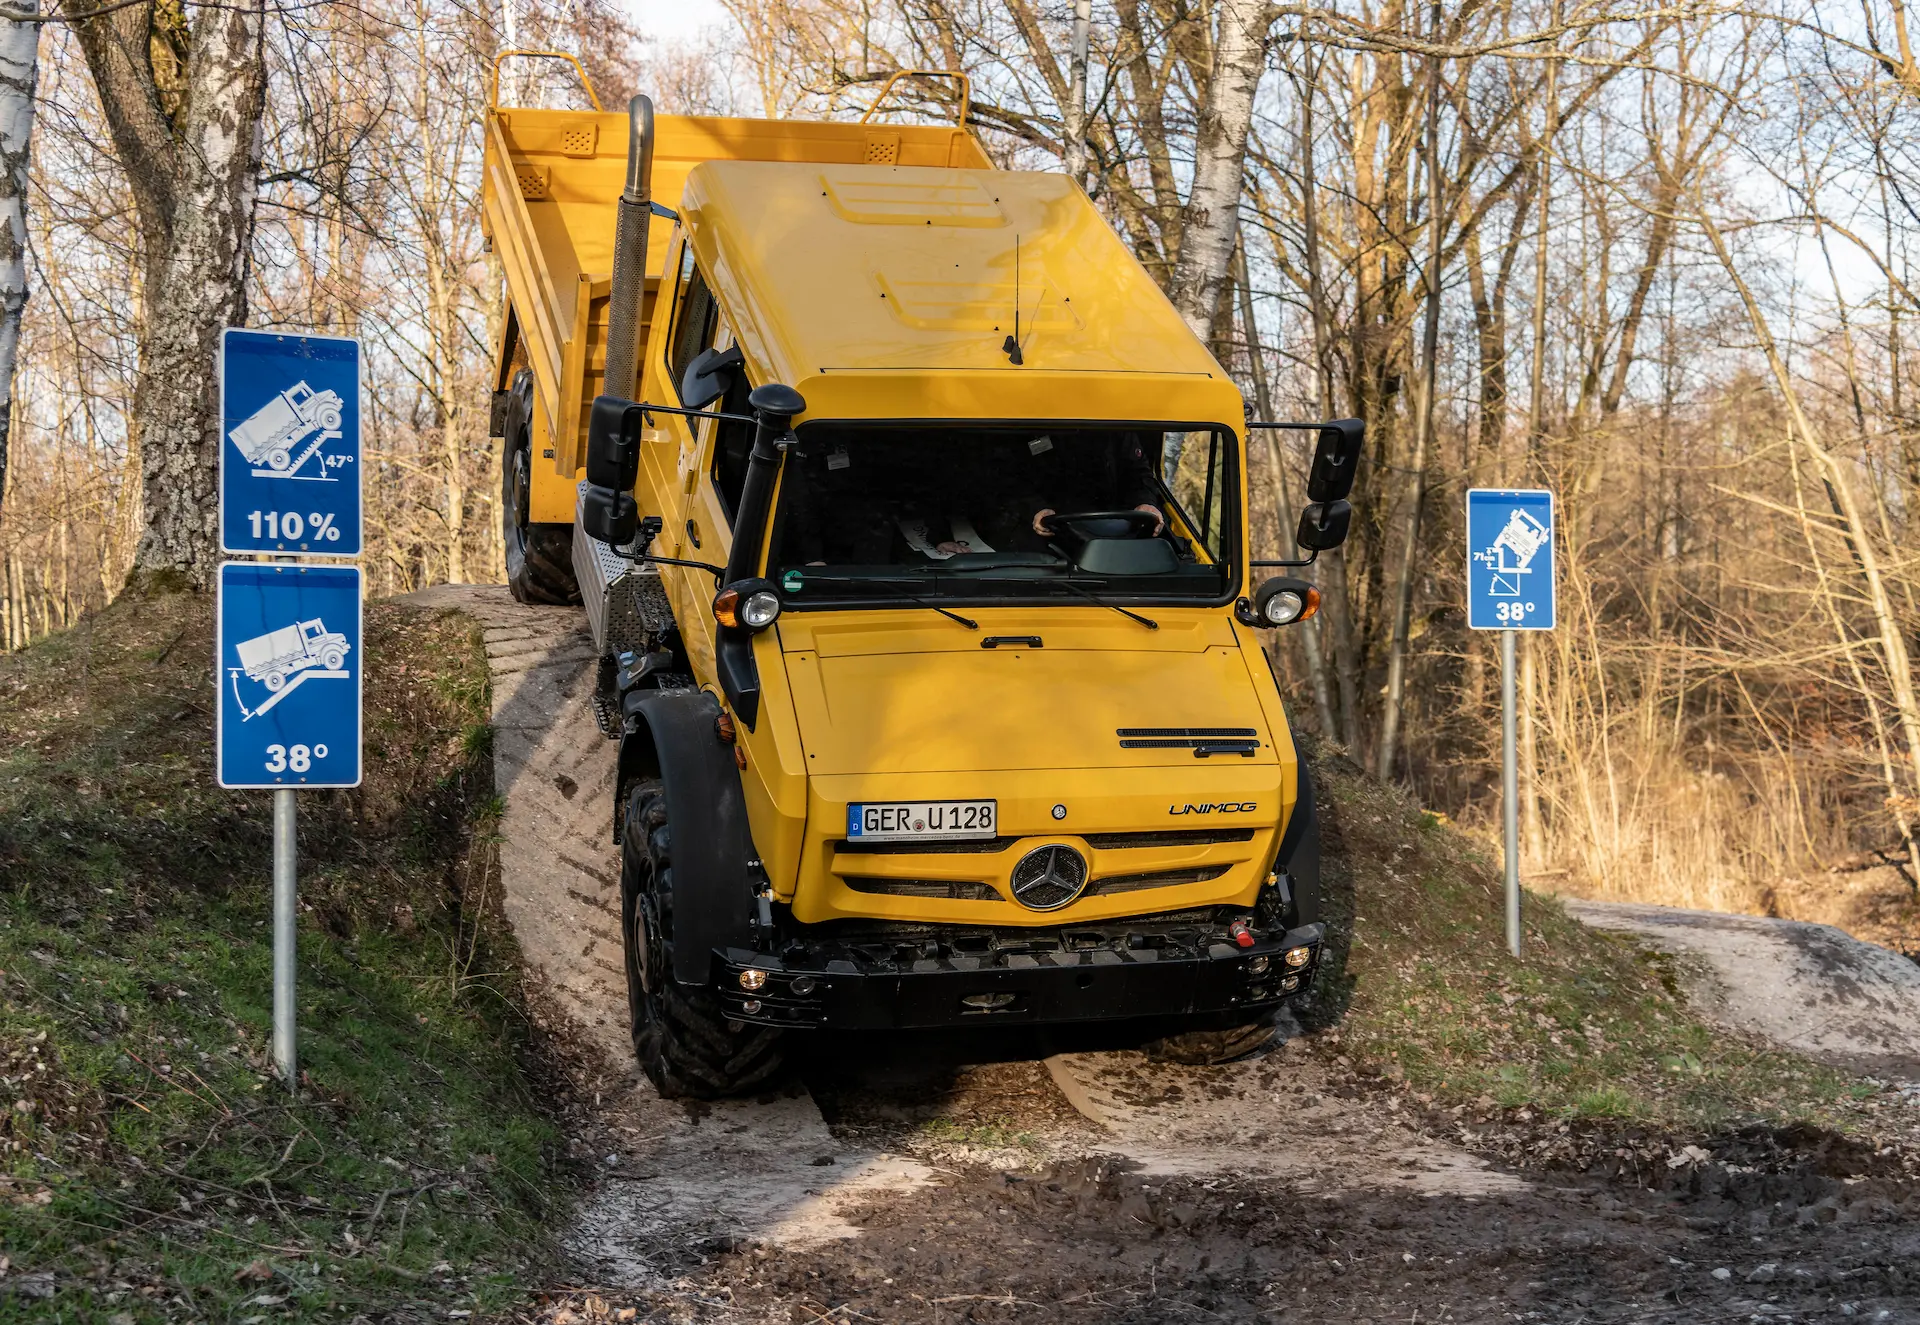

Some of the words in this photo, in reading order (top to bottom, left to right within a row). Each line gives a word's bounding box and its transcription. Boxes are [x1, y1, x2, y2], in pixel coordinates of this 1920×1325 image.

[325, 454, 354, 469] 47°
[1495, 602, 1535, 621] 38°
[265, 743, 329, 773] 38°
[1168, 802, 1257, 815] UNIMOG
[864, 808, 911, 832] GER
[928, 807, 943, 830] U
[949, 805, 992, 829] 128
